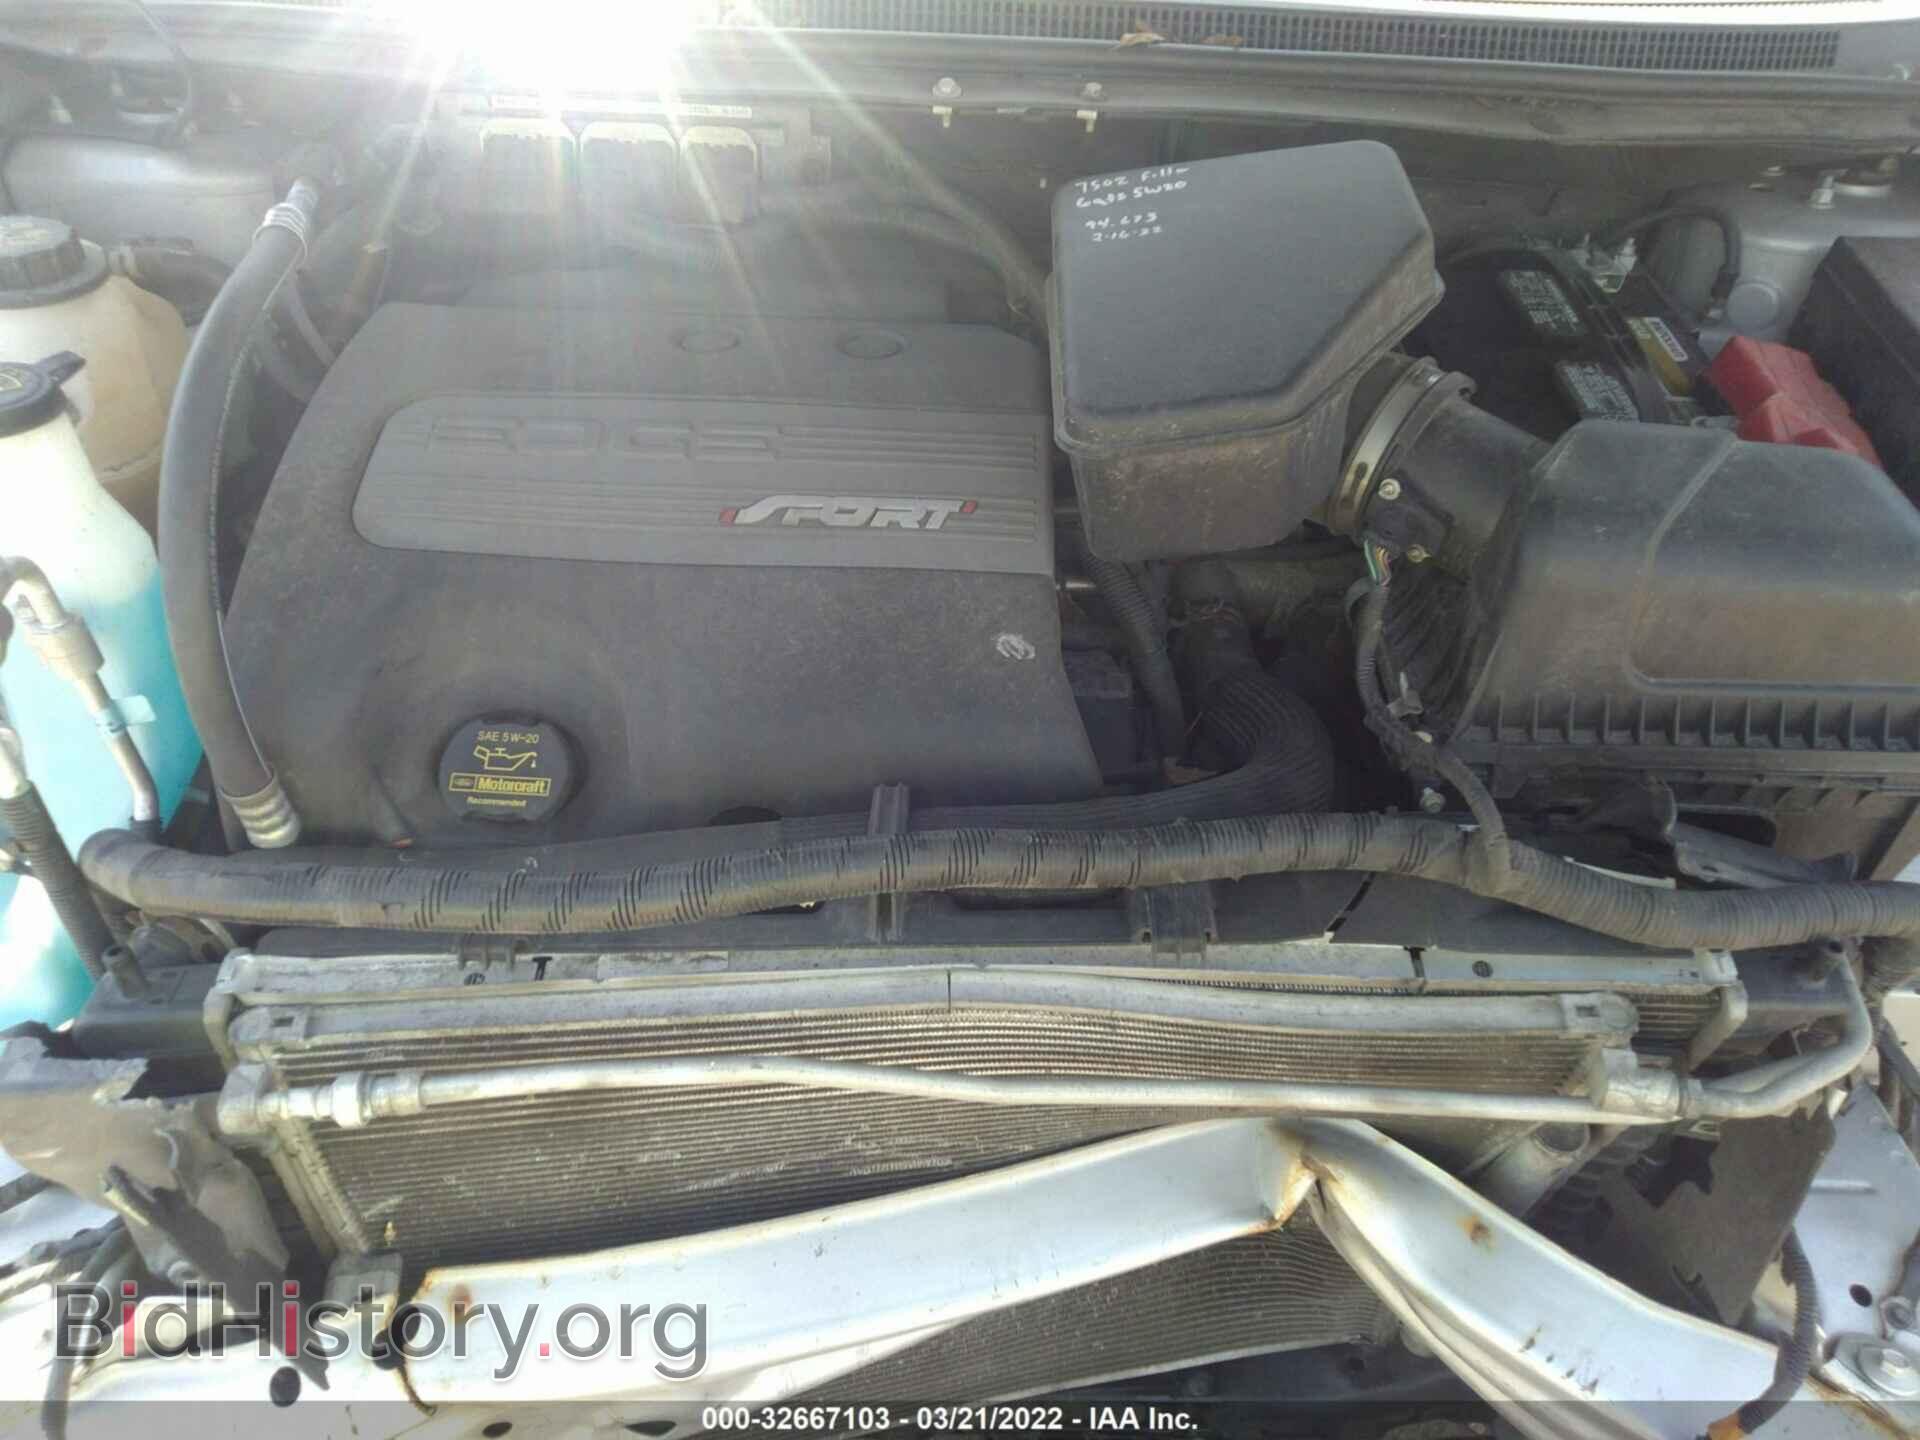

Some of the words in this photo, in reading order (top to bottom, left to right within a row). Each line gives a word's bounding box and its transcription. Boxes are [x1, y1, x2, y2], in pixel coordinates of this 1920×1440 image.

[734, 494, 964, 530] SPORT
[478, 731, 500, 742] SAE
[478, 777, 546, 793] Motorcraft
